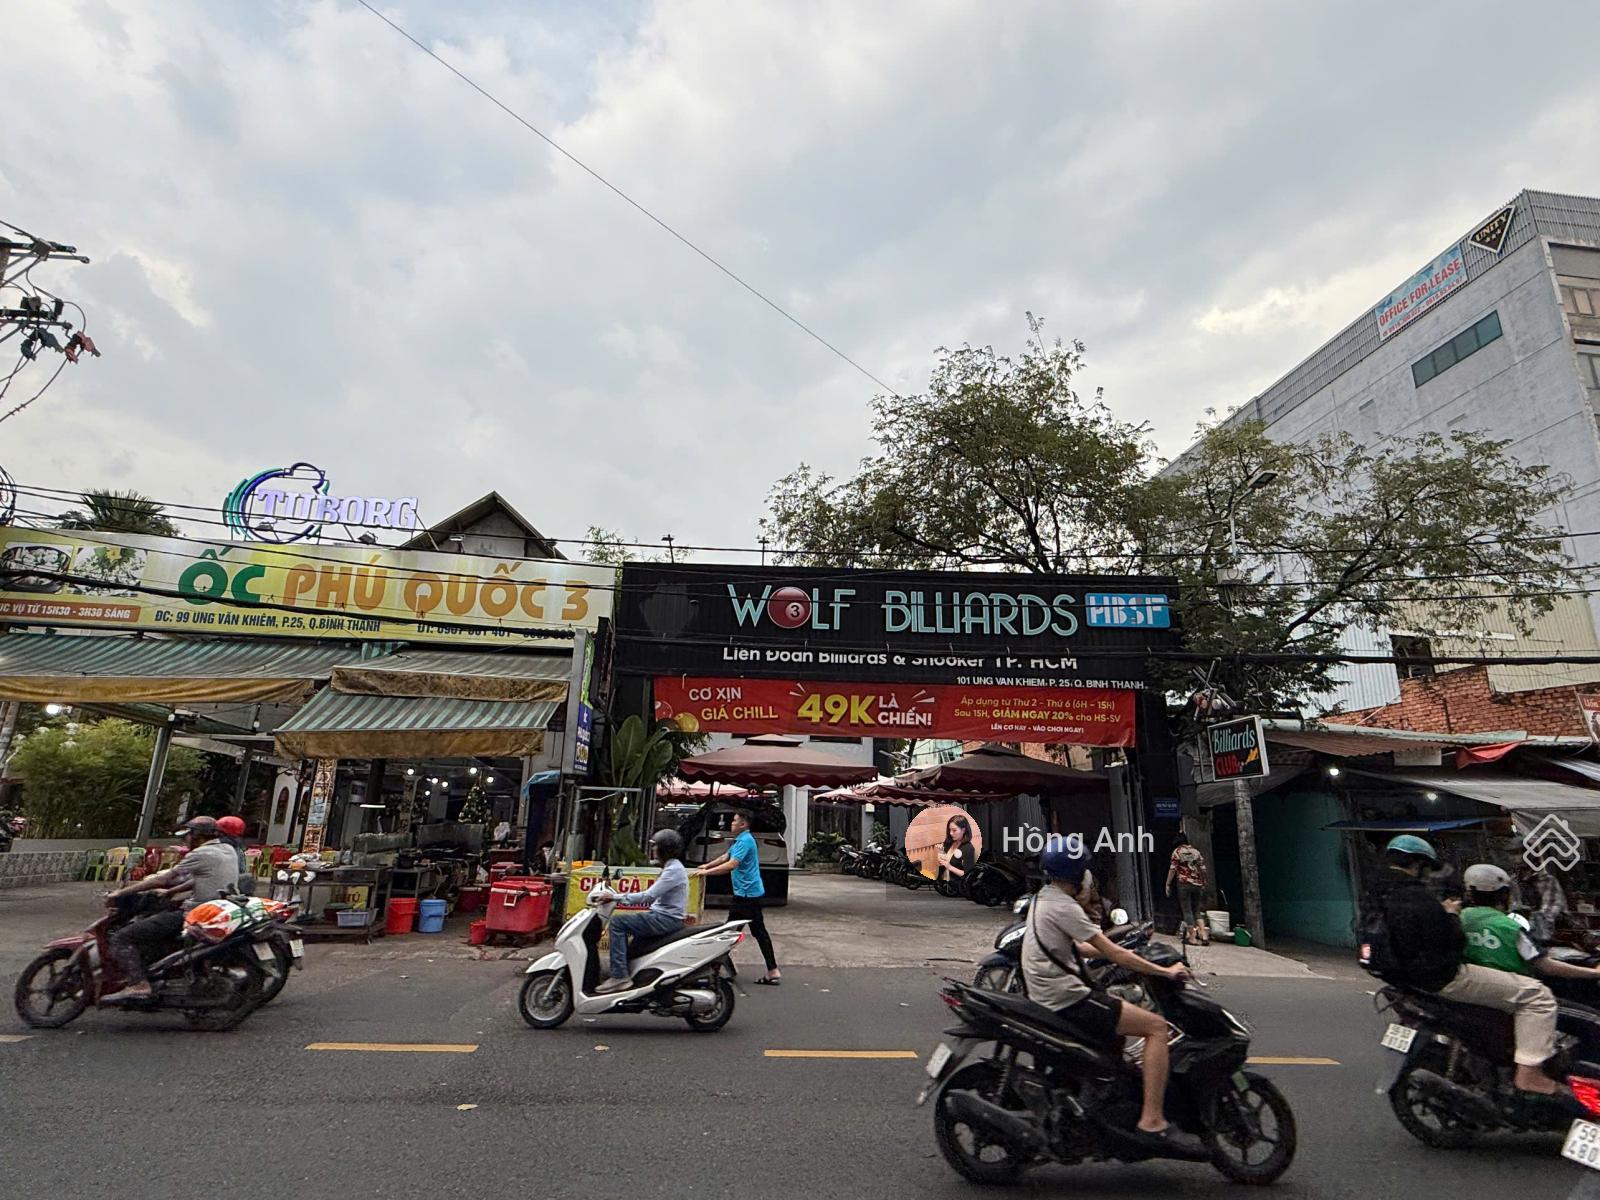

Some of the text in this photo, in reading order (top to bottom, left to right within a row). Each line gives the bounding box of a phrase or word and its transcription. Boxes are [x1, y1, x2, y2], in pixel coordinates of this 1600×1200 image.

[1475, 211, 1508, 242] UNITY
[1380, 297, 1409, 326] OFFICE
[1410, 282, 1428, 303] FOR
[1429, 257, 1460, 288] LEASE
[256, 489, 418, 530] TUBORG
[178, 544, 590, 621] ỐC PHÚ QUỐC 3
[42, 605, 71, 616] 15H30
[78, 607, 102, 618] 3H30
[881, 590, 1079, 637] BILLIARDS
[1089, 594, 1165, 625] HBSF
[155, 610, 173, 622] ĐC:
[176, 611, 190, 623] 99
[192, 612, 215, 624] UNG
[218, 611, 239, 625] VĂN
[241, 613, 278, 629] KHIÊM,
[281, 616, 306, 630] P.25,
[347, 619, 380, 634] THẠNH
[893, 653, 906, 665] &
[956, 676, 971, 686] 101
[972, 676, 993, 686] UNG
[1049, 678, 1058, 687] P.
[1074, 679, 1085, 688] Q.
[688, 686, 742, 703] CƠ XỊN
[878, 692, 899, 709] LÀ
[975, 697, 999, 707] dụng
[1031, 698, 1037, 706] 2
[1065, 700, 1071, 708] 6
[1072, 699, 1088, 709] (6H
[1097, 700, 1115, 711] 15H)
[701, 704, 779, 721] GIÁ CHILL
[797, 694, 876, 725] 49K
[877, 707, 932, 726] CHIẾN!
[954, 707, 1121, 723] Sau 15H, GIẢM NGAY 20% cho HS-SV
[1213, 723, 1256, 754] Billiards
